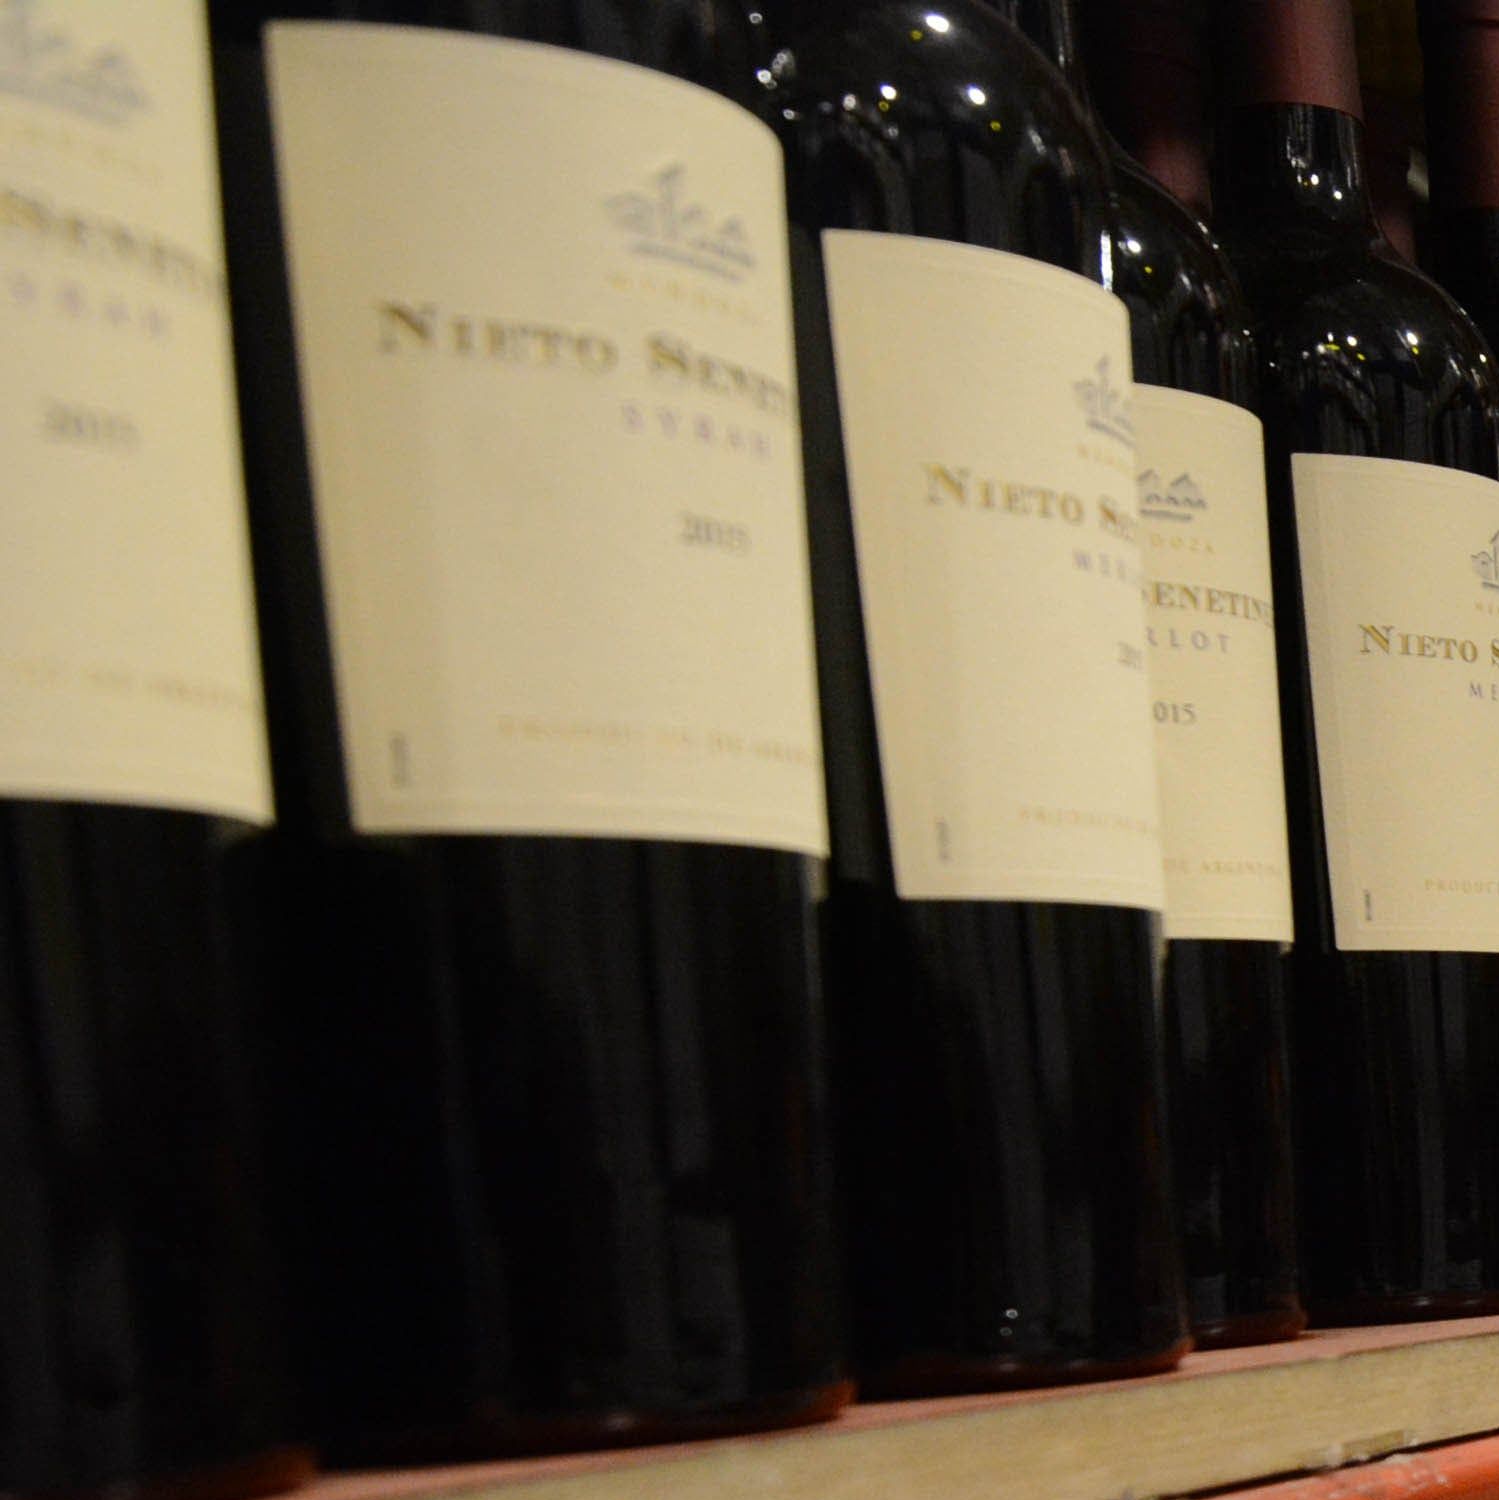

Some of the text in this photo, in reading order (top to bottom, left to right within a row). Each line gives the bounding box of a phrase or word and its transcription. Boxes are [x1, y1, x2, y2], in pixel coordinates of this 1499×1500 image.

[379, 302, 619, 374] NIETO
[923, 461, 1085, 525] NIETO
[1358, 623, 1478, 664] NIETO
